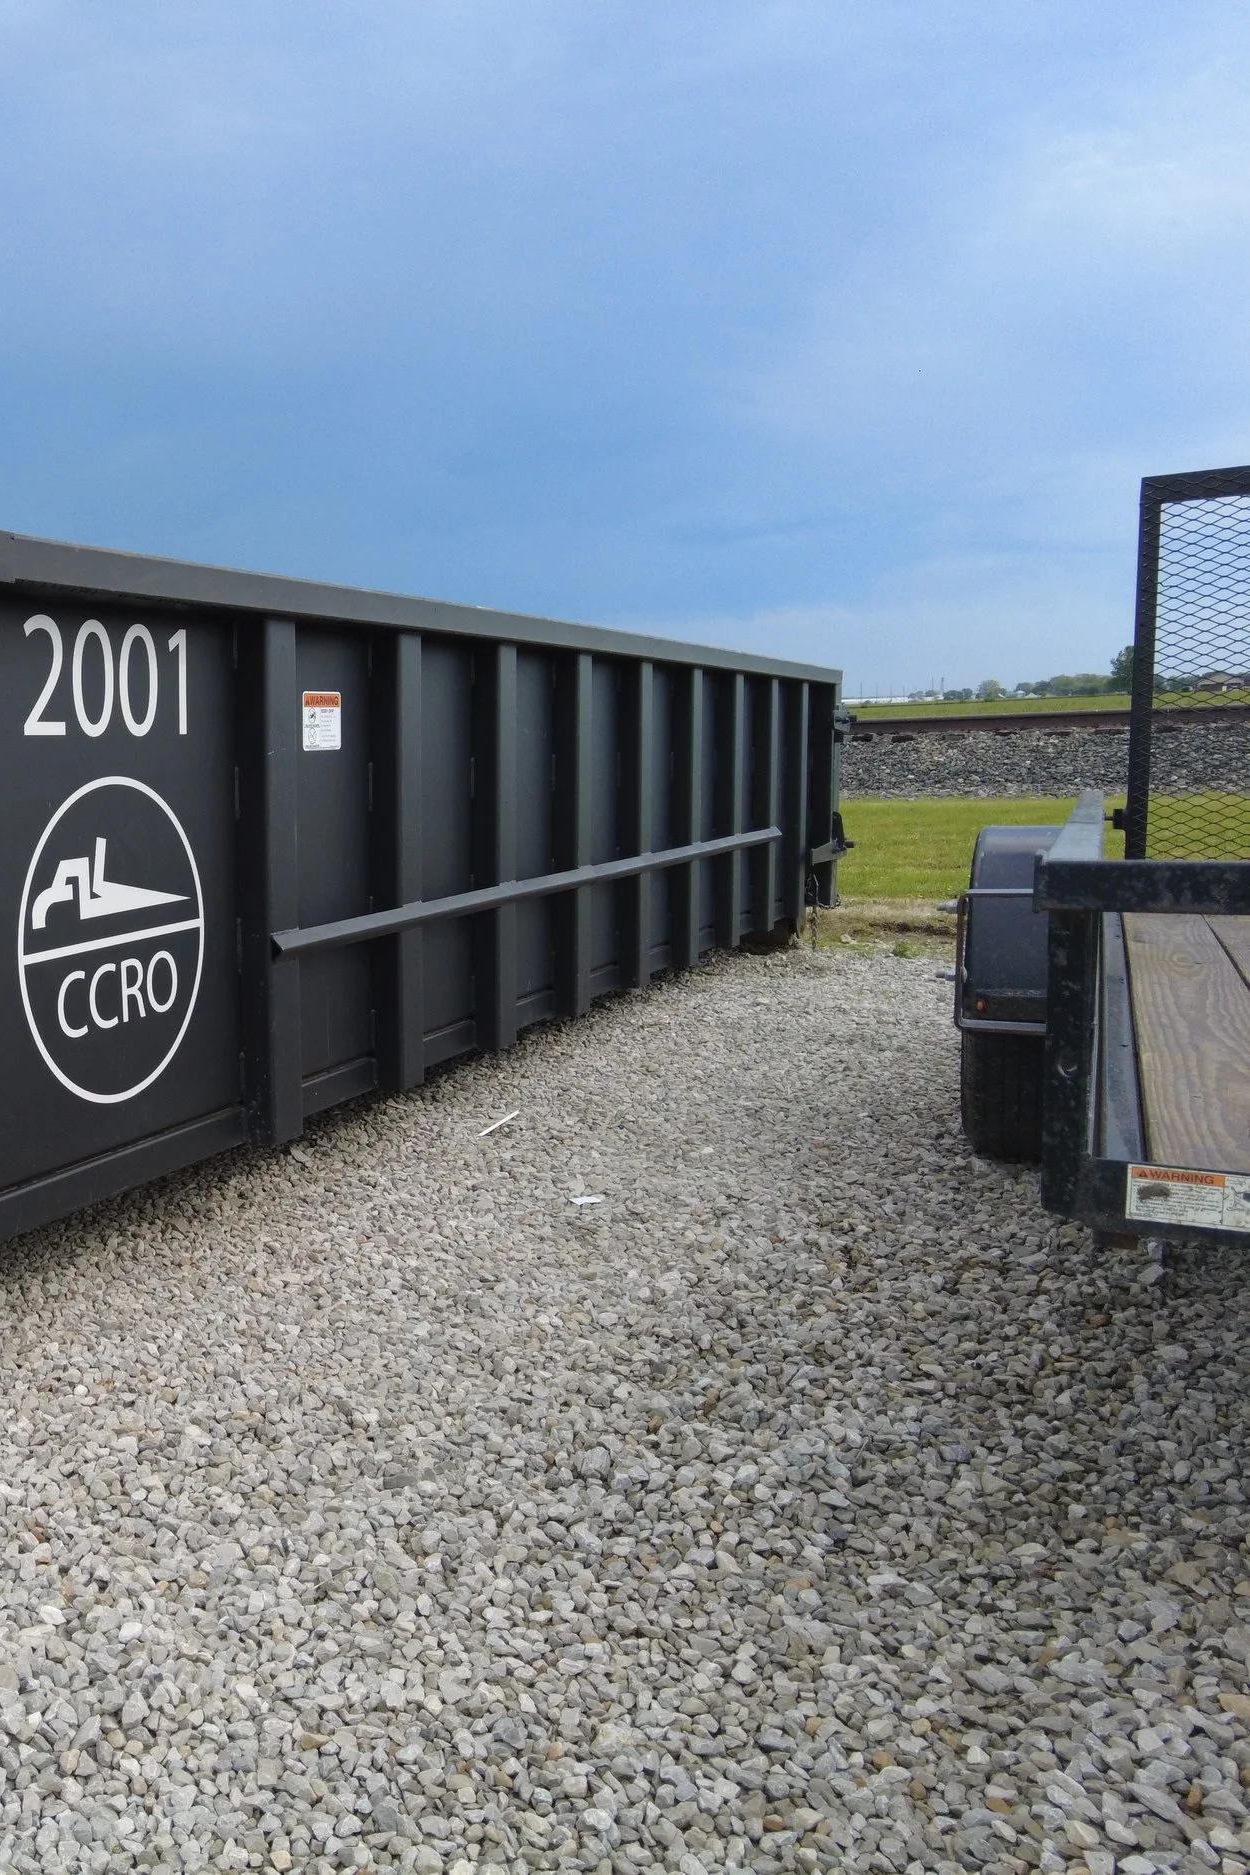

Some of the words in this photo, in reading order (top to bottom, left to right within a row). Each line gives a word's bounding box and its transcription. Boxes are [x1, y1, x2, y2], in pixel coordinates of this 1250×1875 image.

[23, 614, 187, 737] 2001
[310, 695, 339, 706] WARNING
[57, 950, 178, 1038] CCRO
[1149, 1170, 1214, 1185] WARNING
